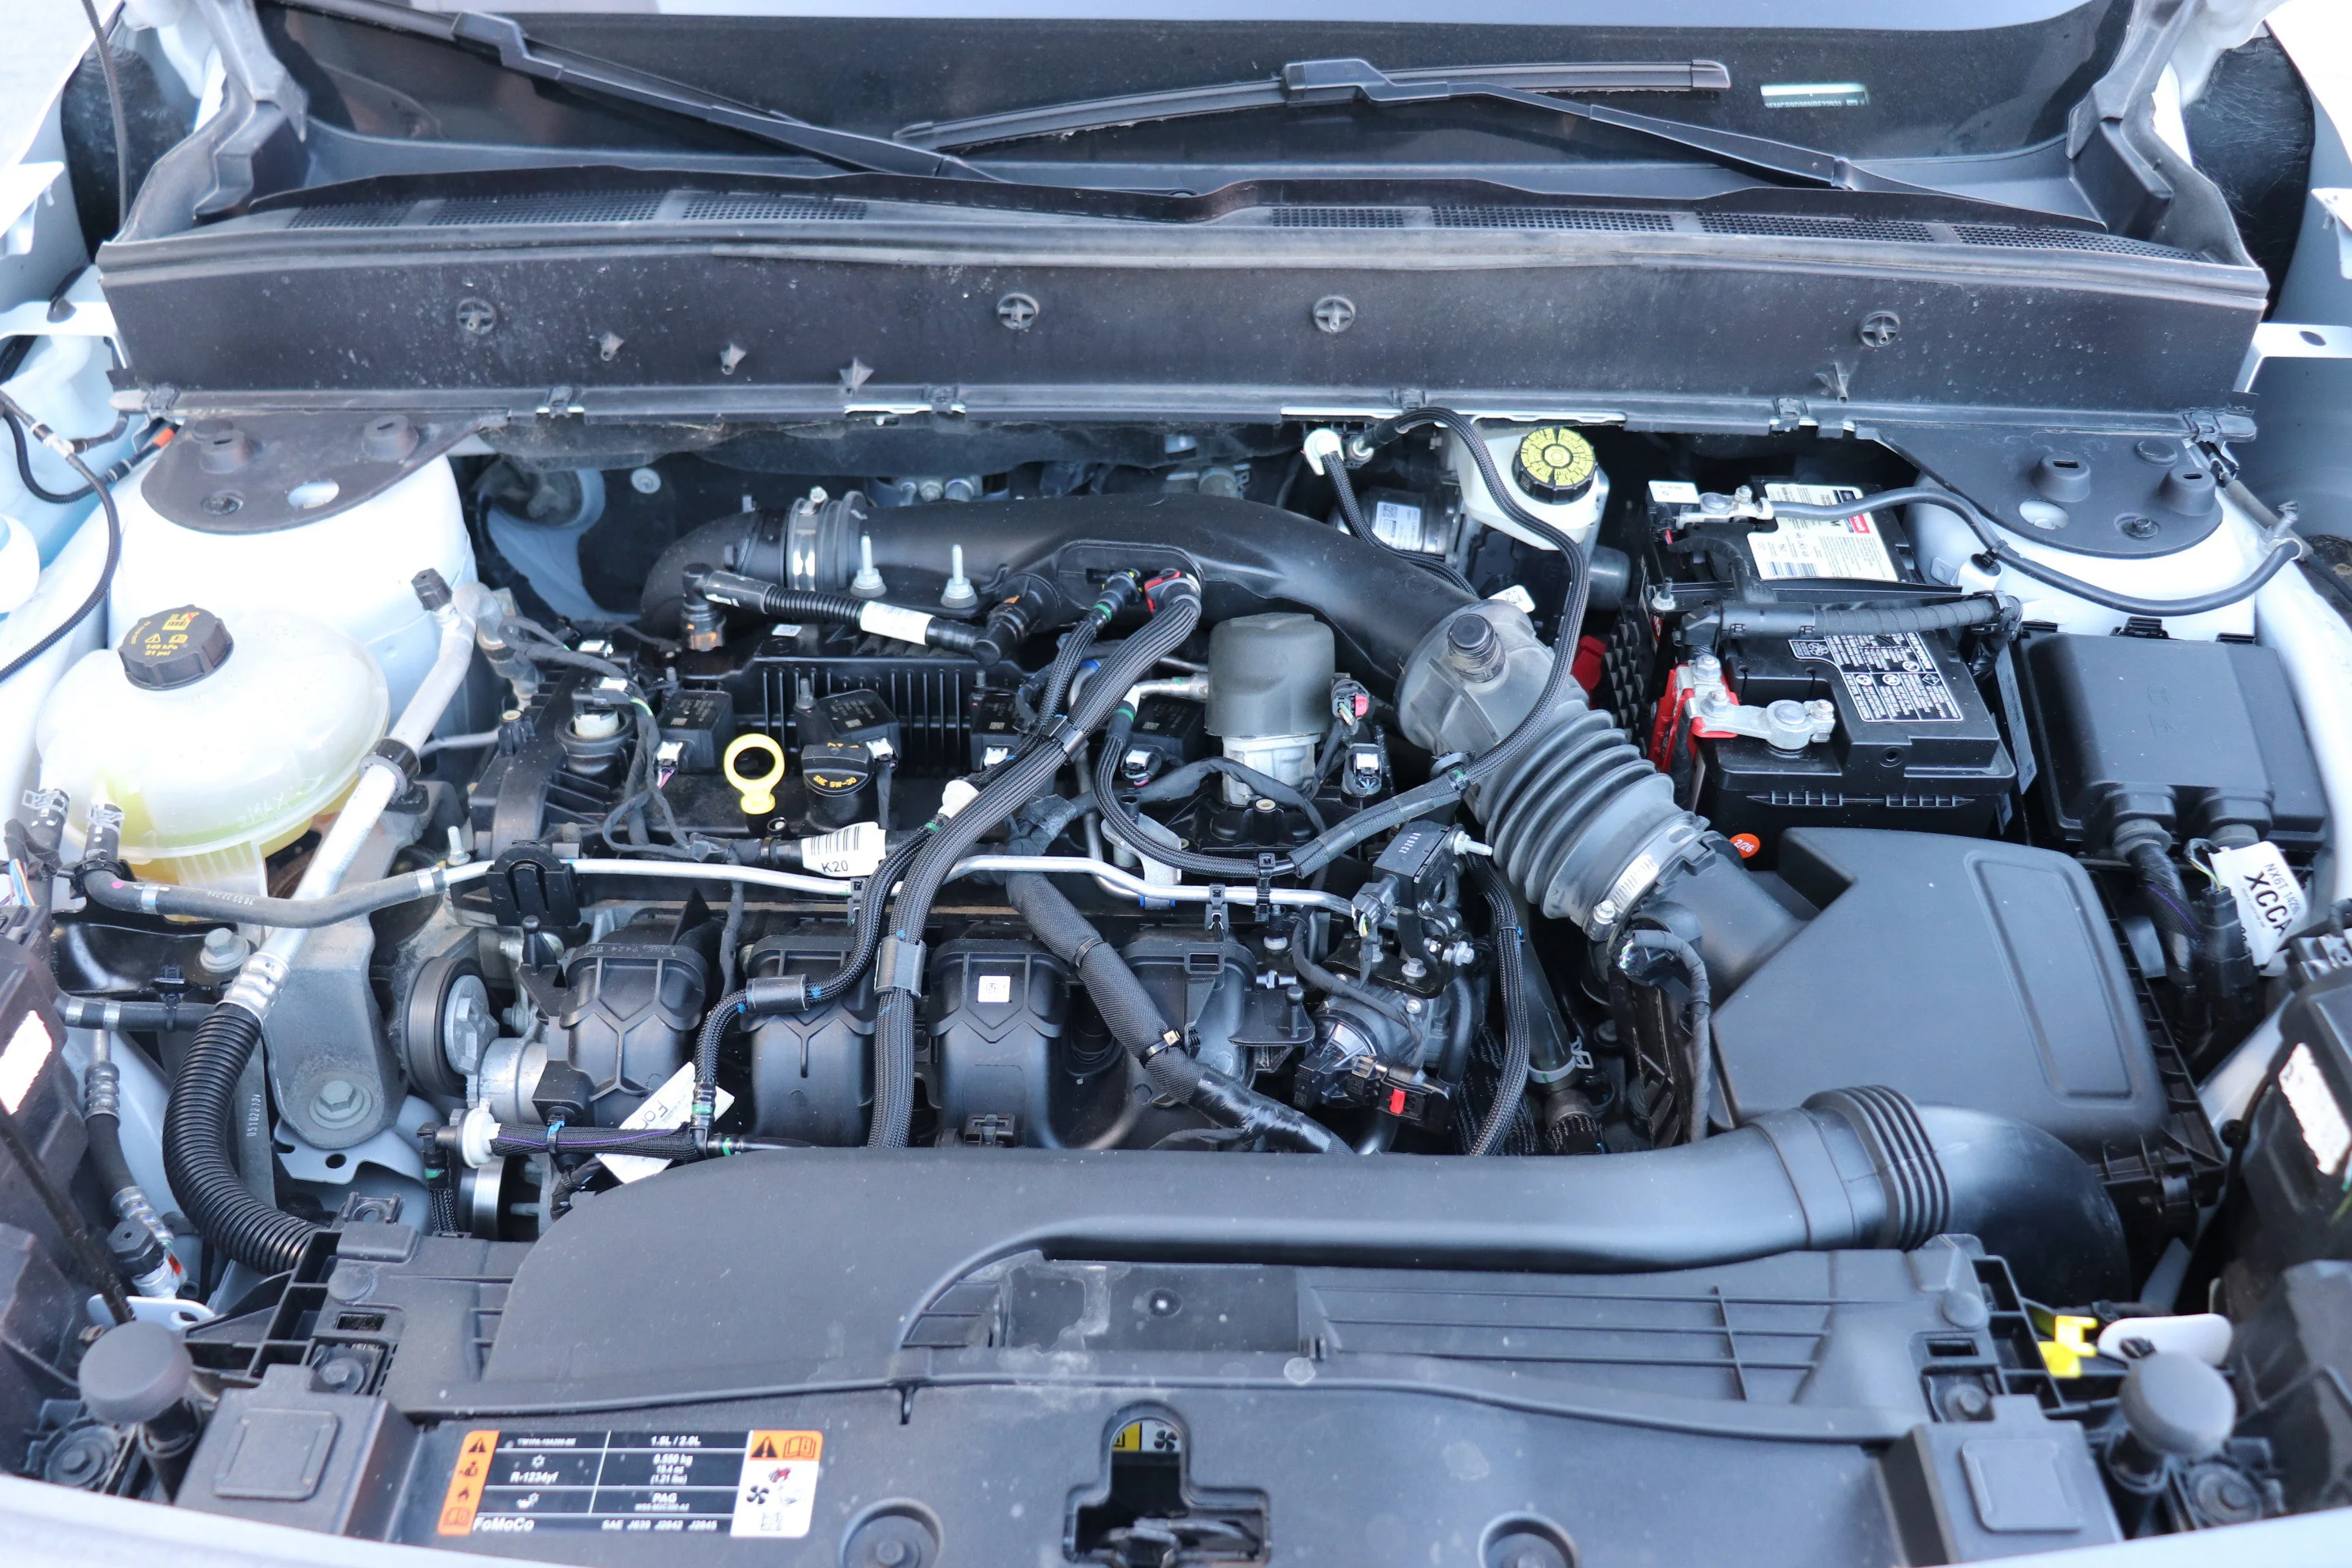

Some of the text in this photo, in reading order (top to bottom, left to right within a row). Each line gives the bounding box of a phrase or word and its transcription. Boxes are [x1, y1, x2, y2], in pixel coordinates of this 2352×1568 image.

[1906, 633, 1932, 669] GER/POISON
[812, 775, 858, 788] SAE 5W-30
[1733, 839, 1755, 853] 2/26
[821, 861, 849, 873] K20
[2265, 862, 2289, 890] NX6T
[2243, 871, 2293, 937] XCCA
[680, 1453, 693, 1468] kg
[509, 1471, 560, 1485] R-1234yf
[652, 1492, 677, 1503] PAG
[472, 1517, 535, 1532] FoMoCo
[601, 1519, 624, 1531] SAE
